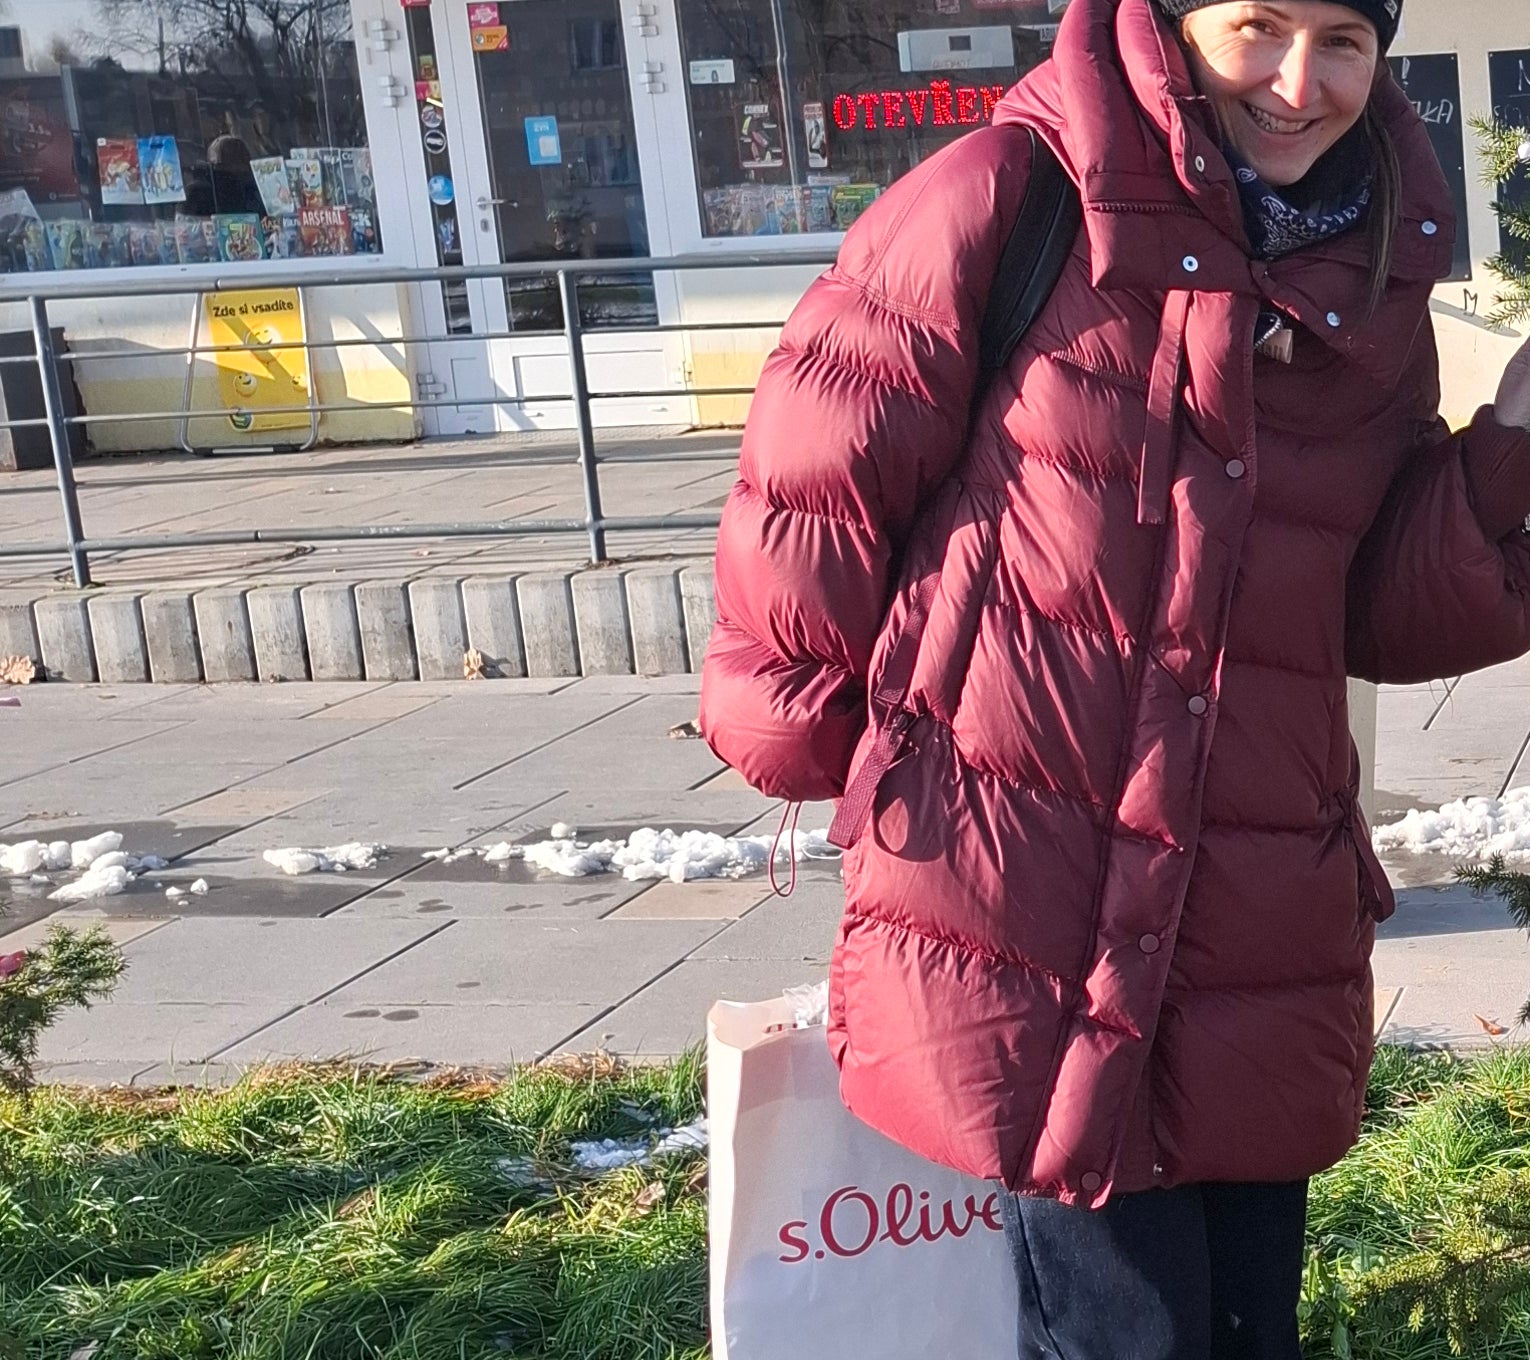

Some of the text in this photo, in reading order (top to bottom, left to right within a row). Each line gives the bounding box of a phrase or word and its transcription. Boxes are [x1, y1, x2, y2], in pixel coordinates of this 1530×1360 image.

[833, 79, 1004, 130] OTEVŘEN
[302, 210, 345, 226] ARSENAL
[213, 298, 295, 318] Zde si vsadíte
[778, 1182, 1005, 1264] s.Olive
